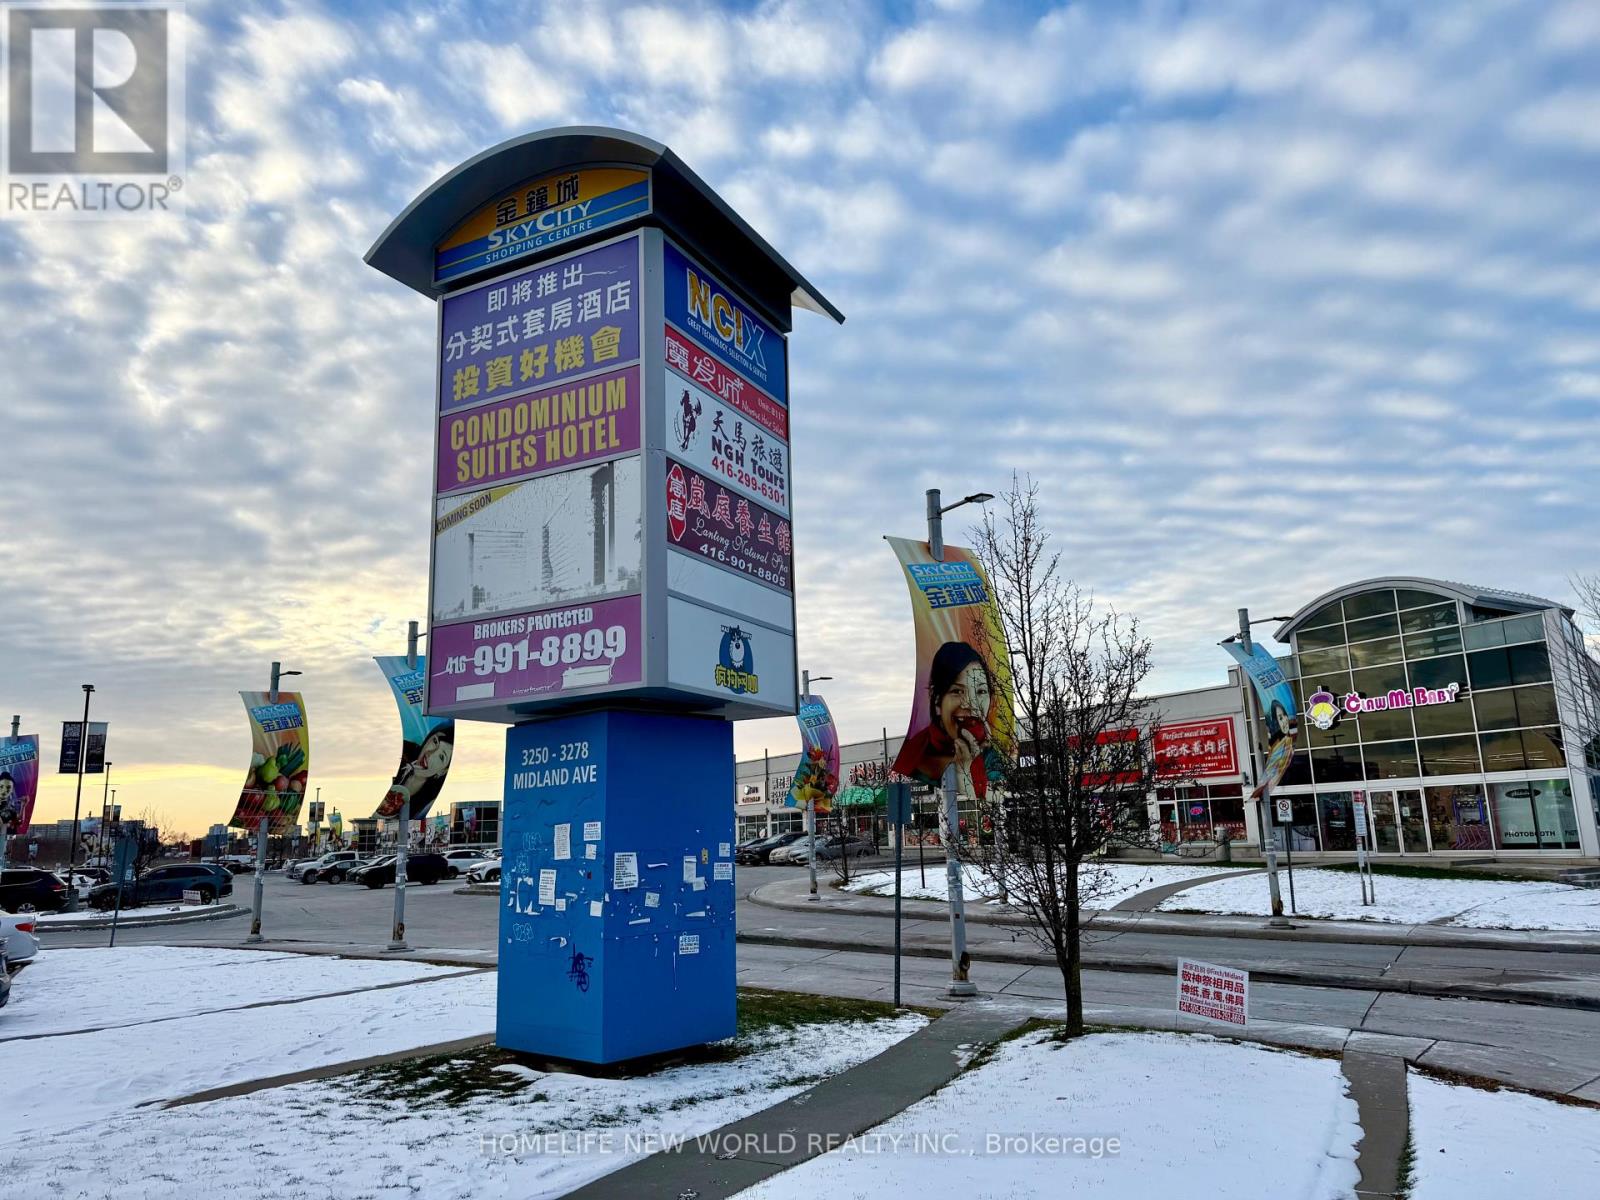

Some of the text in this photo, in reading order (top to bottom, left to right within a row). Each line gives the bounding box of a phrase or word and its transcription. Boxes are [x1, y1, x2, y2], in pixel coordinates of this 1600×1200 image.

[496, 174, 580, 227] 金鐘城
[485, 219, 593, 263] SHOPPING CENTRE
[487, 264, 583, 313] 即將推出
[446, 280, 631, 362] 分契式套房酒店
[687, 267, 767, 371] NCIX
[453, 325, 622, 401] 投資好機會
[687, 317, 701, 332] GREAT
[729, 347, 749, 368] SELECTION
[753, 367, 767, 382] SERVICE
[450, 377, 627, 450] CONDOMINIUM
[457, 415, 620, 482] SUITES HOTEL
[711, 435, 744, 468] NGH
[712, 410, 783, 474] 天馬旅遊
[711, 456, 785, 507] 416-299-6301
[436, 492, 492, 533] COMING SOON
[692, 517, 730, 551] Lanting
[731, 536, 769, 564] Natural
[700, 543, 786, 587] 416-901-8805
[924, 583, 990, 609] 金鐘城
[474, 607, 594, 640] BROKERS PROTECTED
[513, 764, 597, 790] MIDLAND AVE
[521, 746, 549, 766] 3250
[560, 741, 589, 762] 3278
[1504, 830, 1556, 838] PHOTOBOTH
